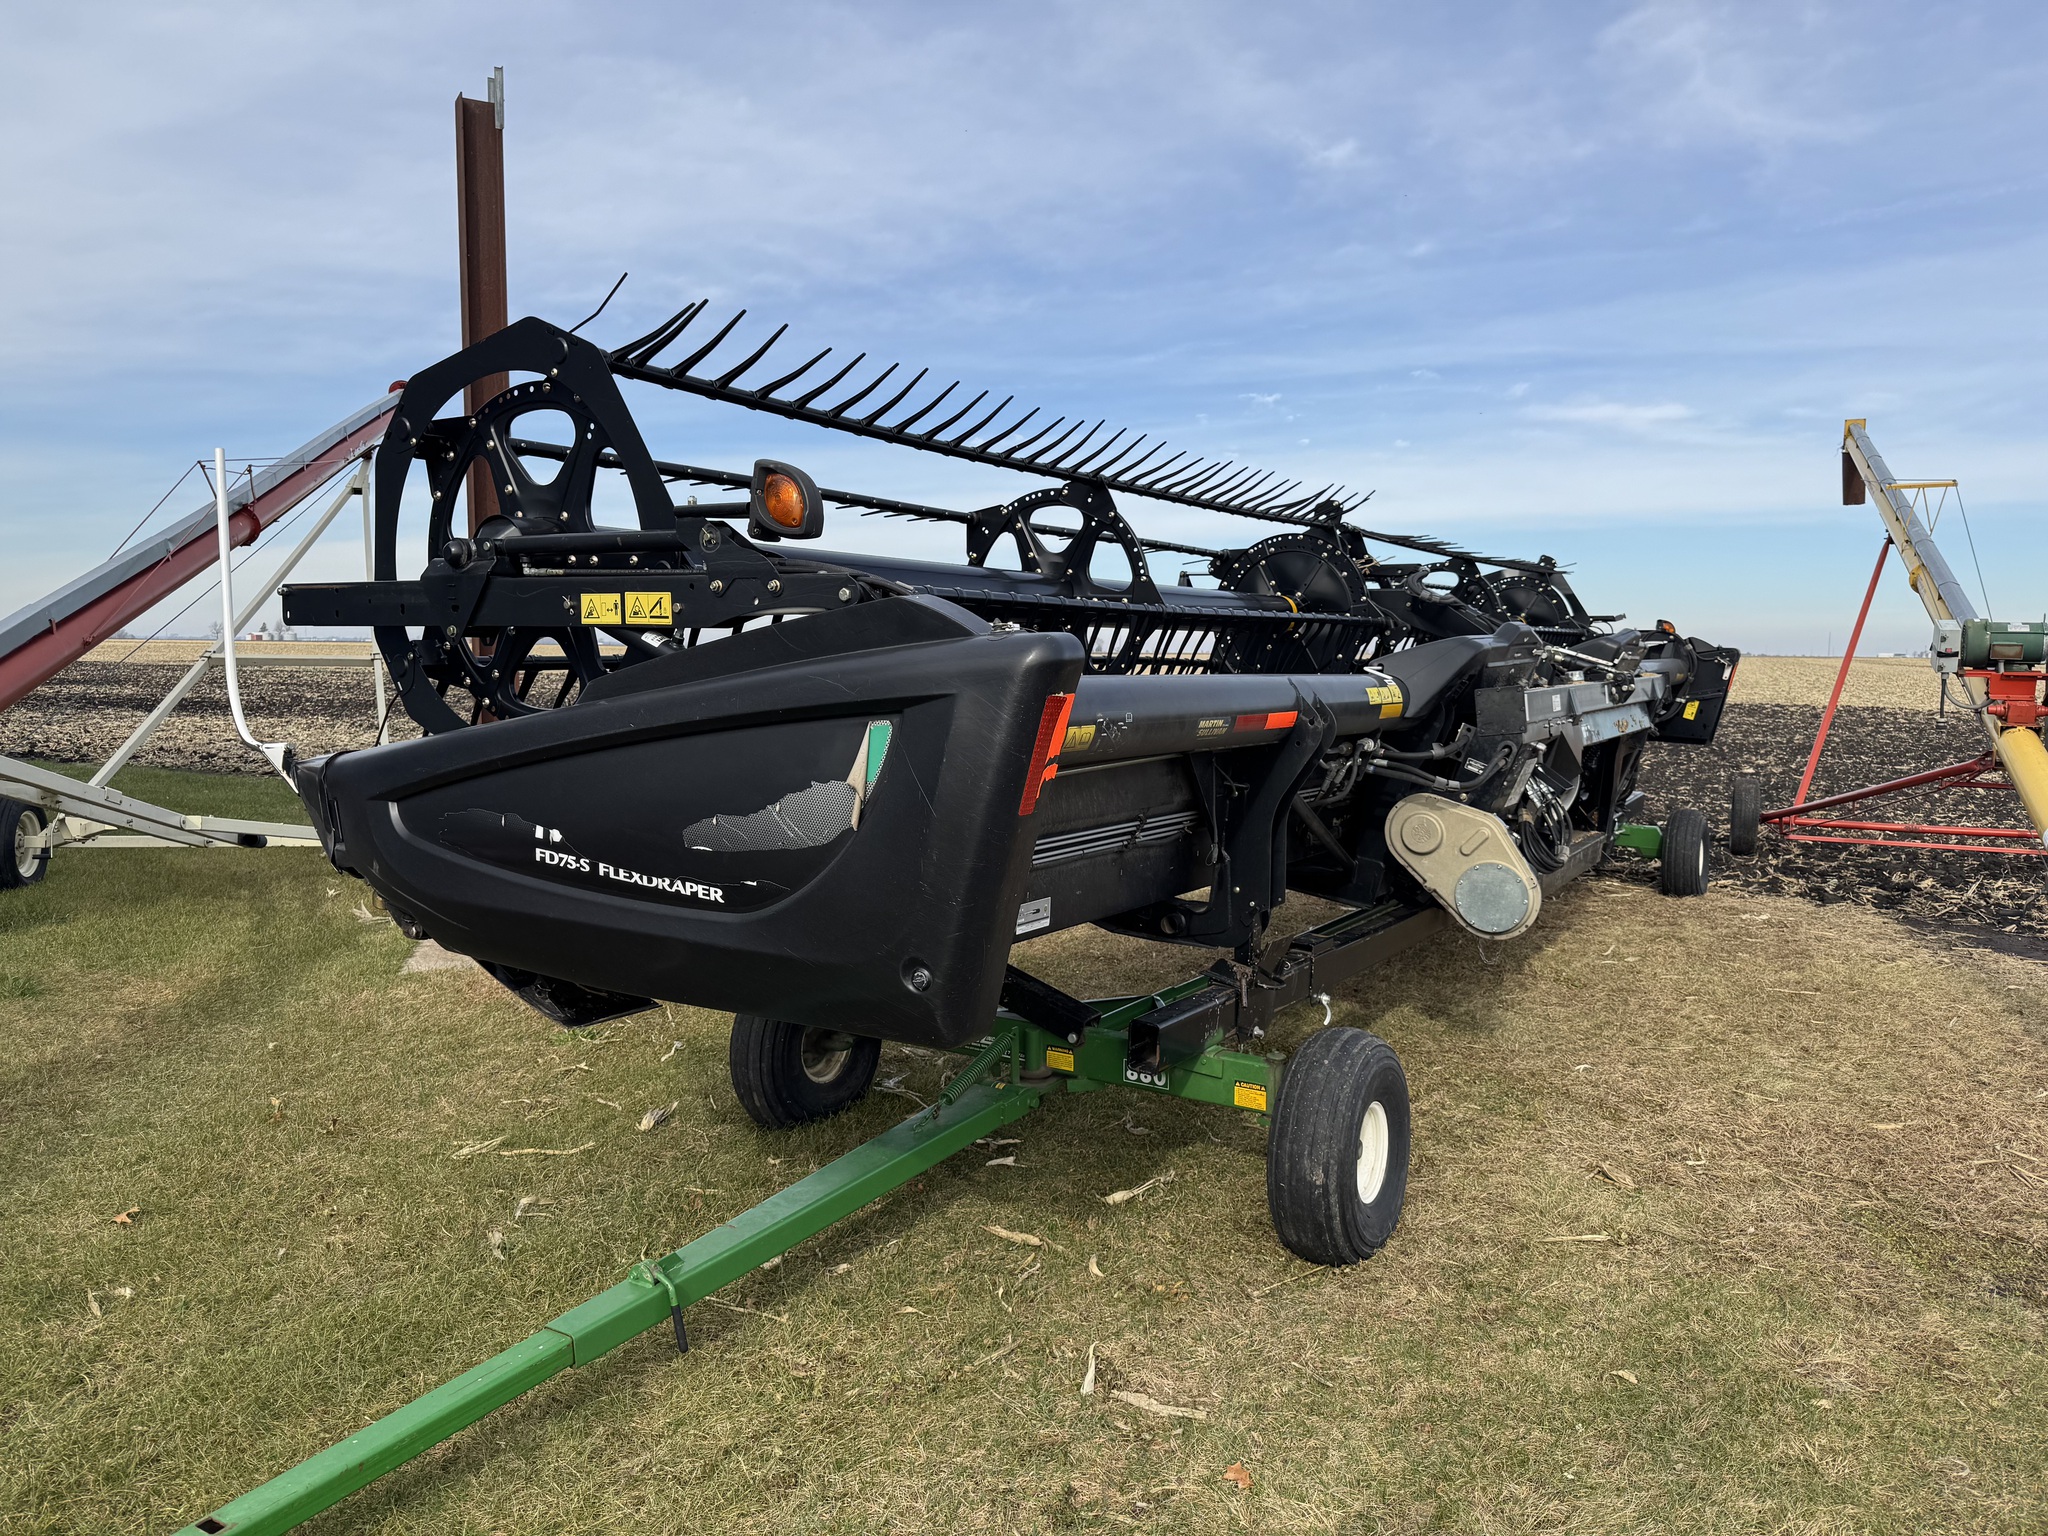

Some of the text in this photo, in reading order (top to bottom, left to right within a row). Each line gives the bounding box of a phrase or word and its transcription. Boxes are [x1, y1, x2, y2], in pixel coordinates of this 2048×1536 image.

[1198, 720, 1224, 728] MARTIN
[599, 862, 725, 903] FLEXDRAPER
[1240, 1081, 1261, 1091] CAUTION
